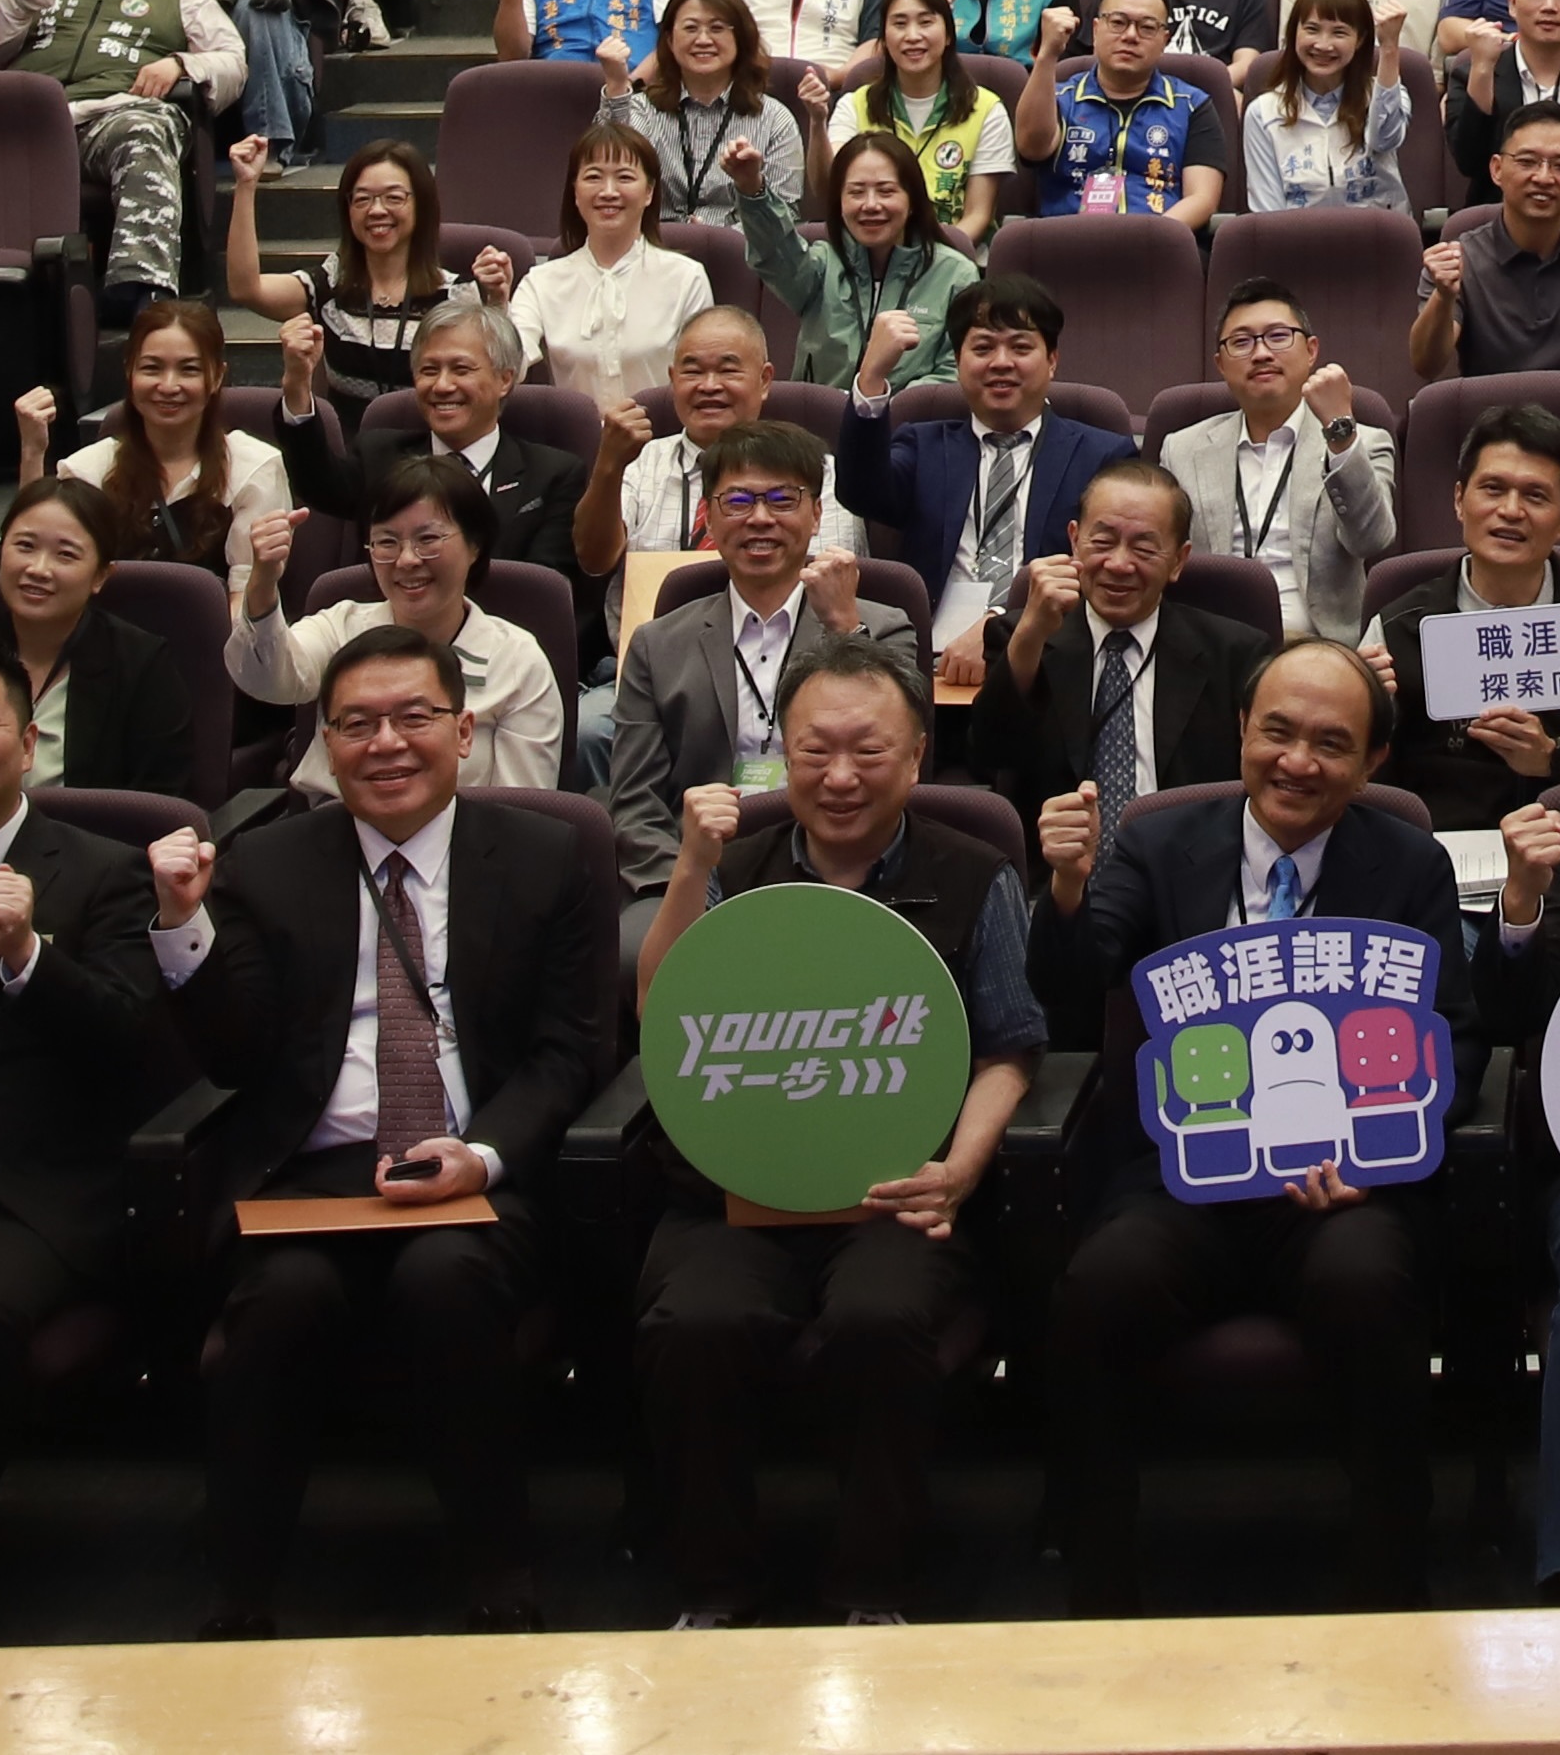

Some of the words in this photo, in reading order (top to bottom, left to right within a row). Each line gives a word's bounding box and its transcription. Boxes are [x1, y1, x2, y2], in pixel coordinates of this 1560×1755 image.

[1169, 4, 1229, 33] UTICA
[1146, 929, 1429, 1027] 職涯課程
[701, 1057, 834, 1103] 下一步
